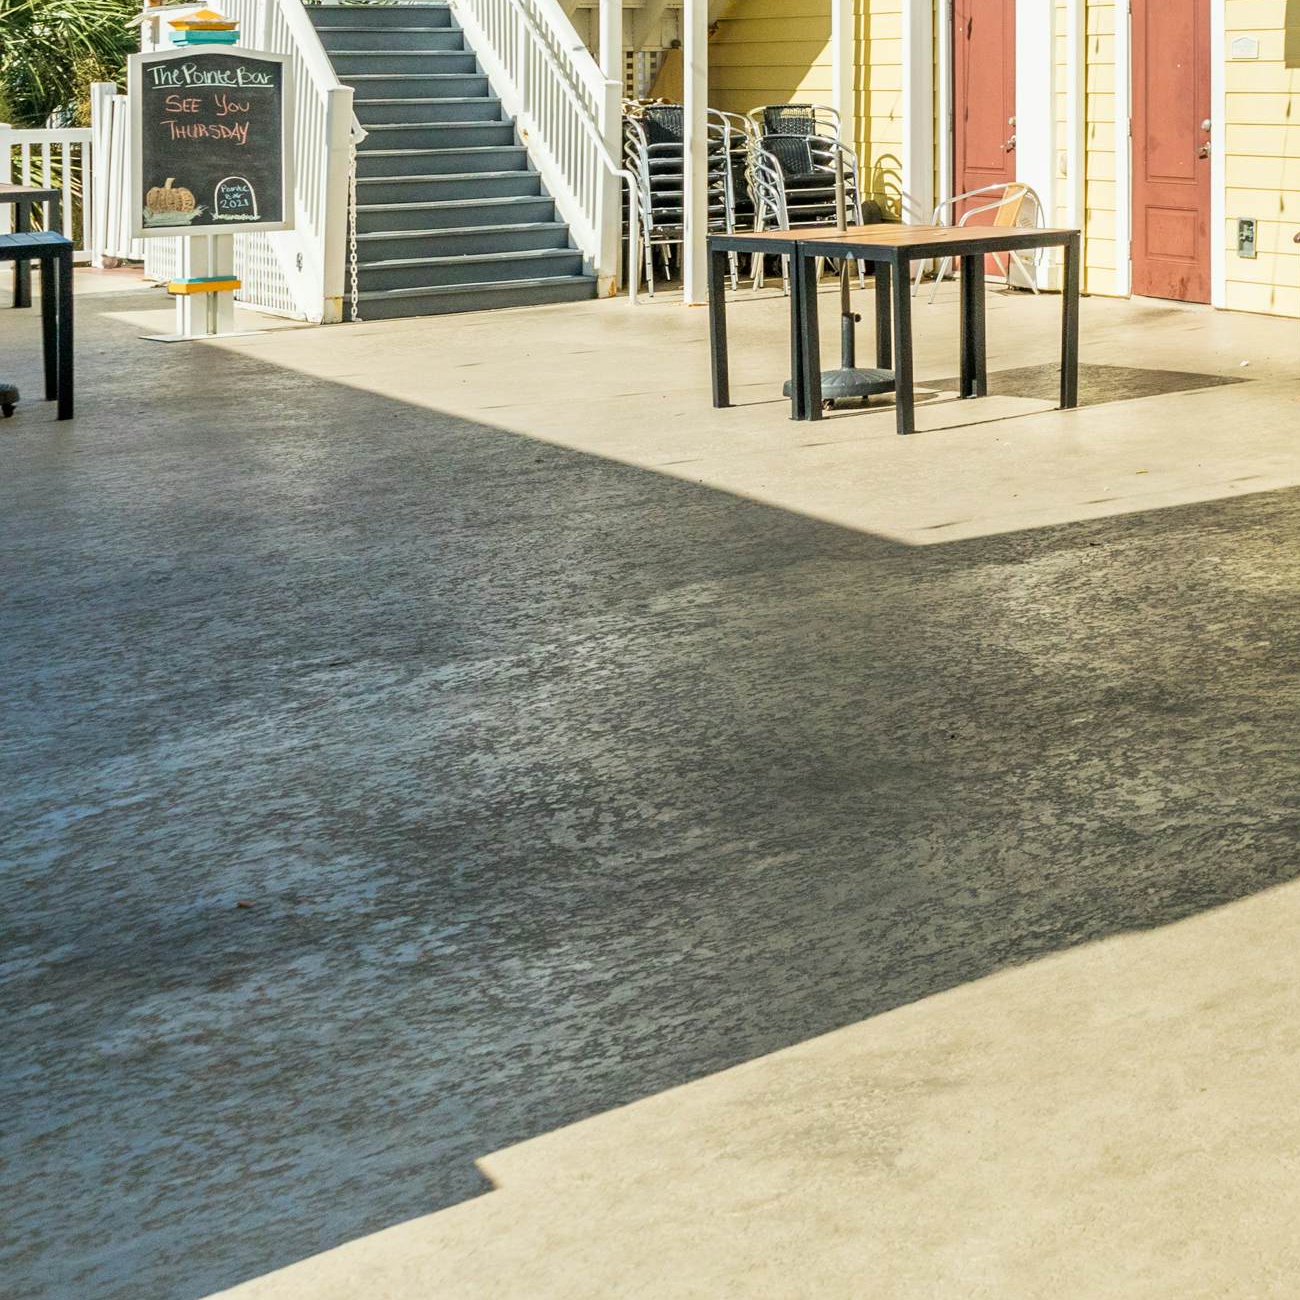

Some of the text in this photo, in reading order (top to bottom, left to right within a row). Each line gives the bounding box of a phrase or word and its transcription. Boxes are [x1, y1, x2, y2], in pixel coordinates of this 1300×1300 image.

[146, 62, 273, 86] The Pointe Bar
[165, 95, 202, 113] SEE
[160, 120, 250, 146] THURSDAY
[220, 198, 249, 208] 2021
